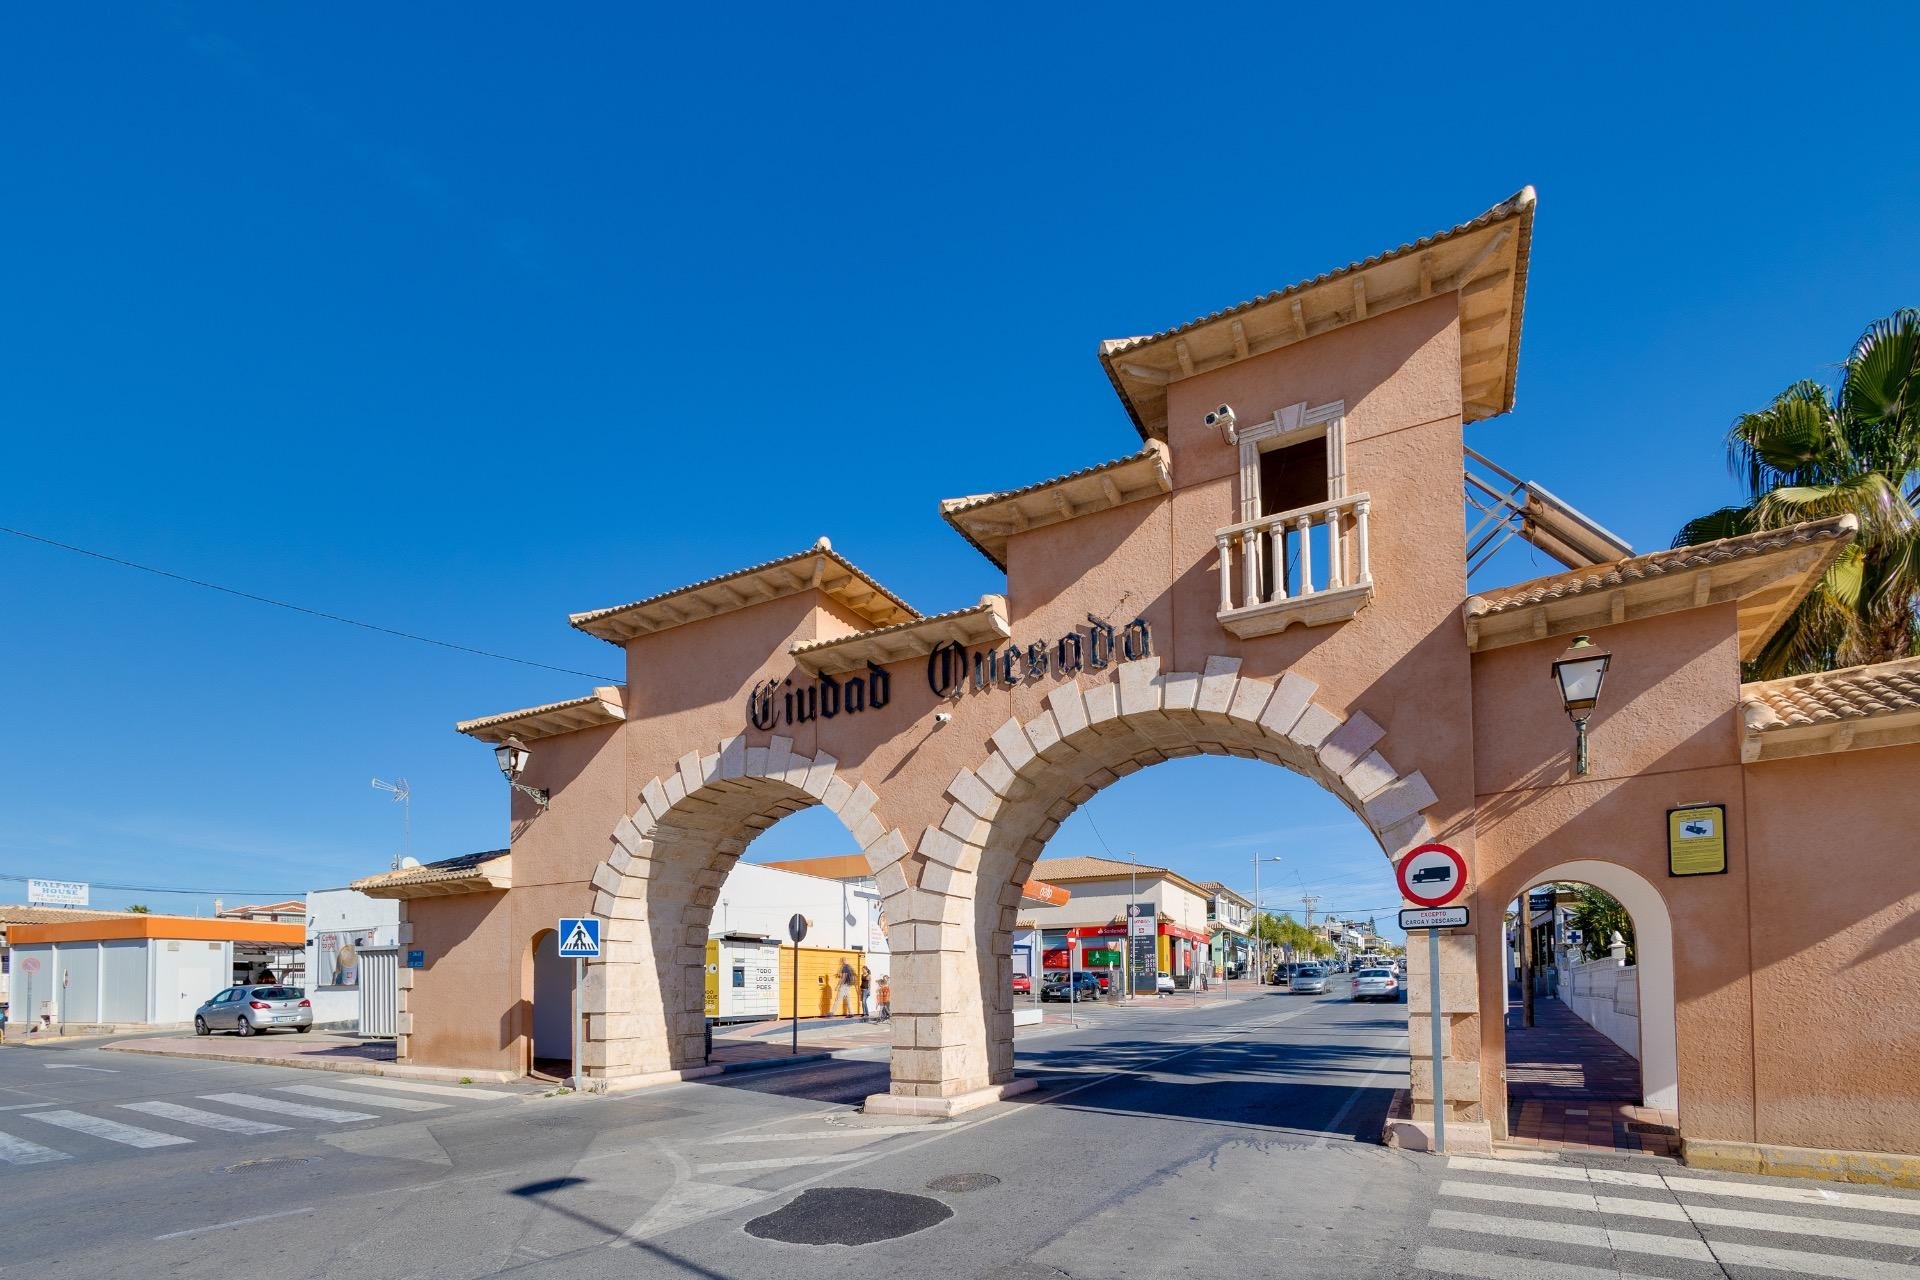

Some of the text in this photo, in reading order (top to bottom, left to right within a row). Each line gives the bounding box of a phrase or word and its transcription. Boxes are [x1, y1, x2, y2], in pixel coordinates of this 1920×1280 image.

[752, 612, 1151, 730] Ciudad Quesada
[33, 881, 85, 890] HALFWAY
[42, 888, 78, 896] HOUSE
